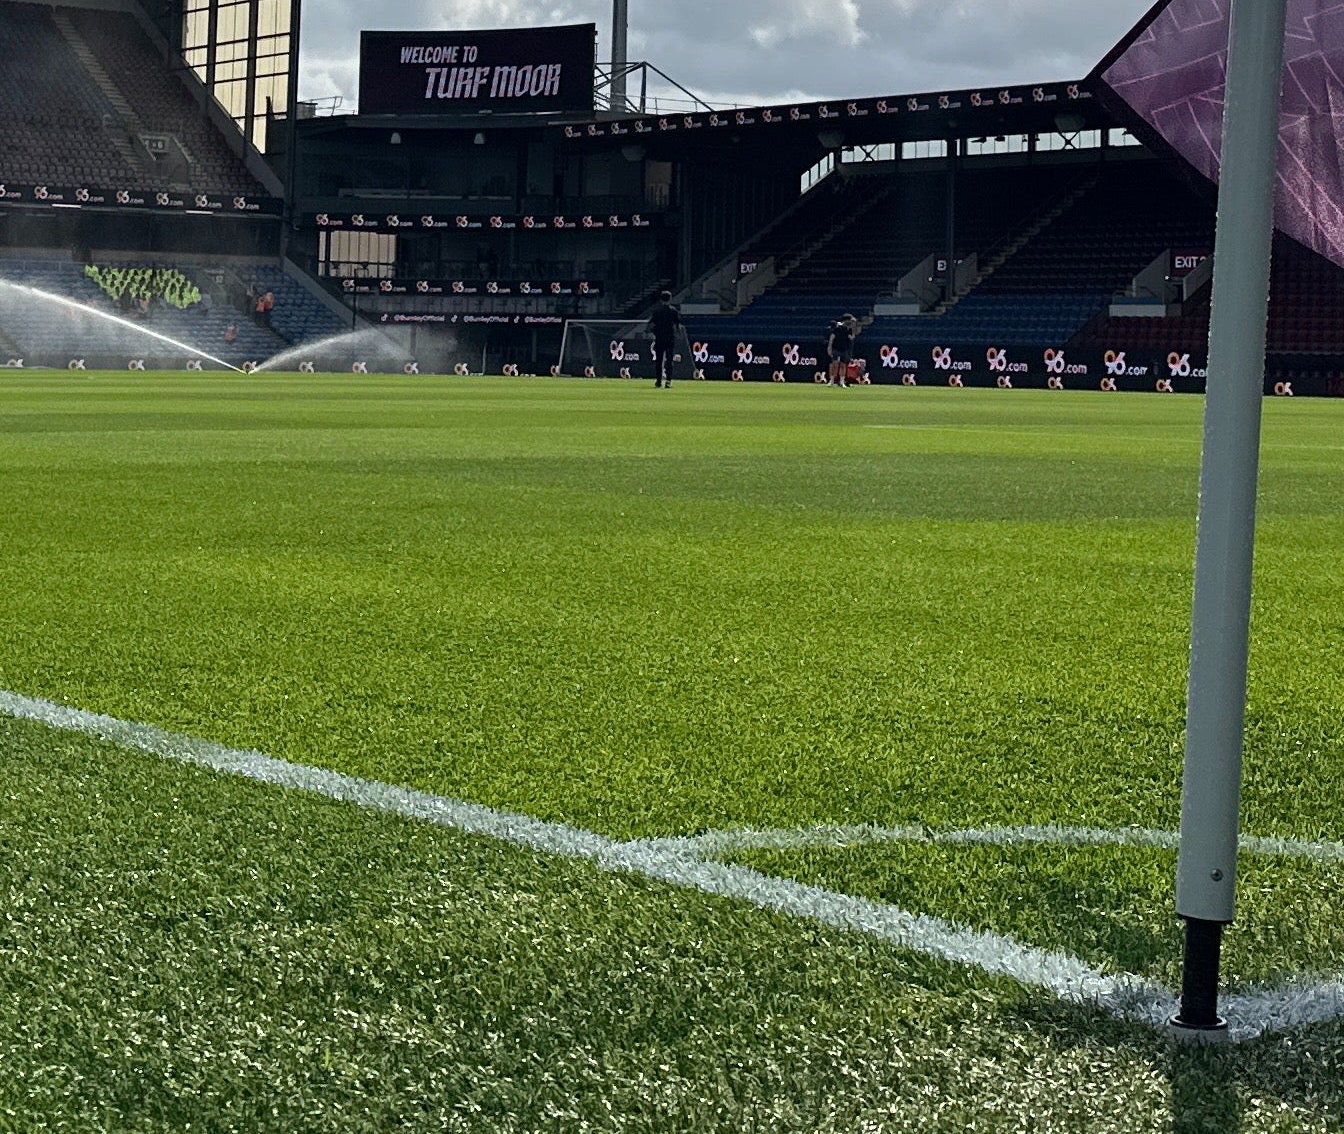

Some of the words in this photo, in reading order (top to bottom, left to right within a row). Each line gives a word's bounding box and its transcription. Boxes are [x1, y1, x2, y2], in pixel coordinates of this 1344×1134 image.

[400, 46, 459, 63] WELCOME
[462, 46, 478, 63] TO
[425, 66, 490, 98] TURF
[490, 64, 562, 98] MOOR
[1175, 256, 1199, 268] EXIT
[609, 340, 640, 361] 96.com
[692, 341, 725, 364] 96.com
[736, 342, 770, 364] 96.com
[782, 343, 817, 366] 96.com
[879, 345, 918, 369] 96.com
[932, 346, 972, 370] 96.com
[986, 347, 1028, 373] 96.com
[1044, 348, 1087, 374] 96.com
[1167, 351, 1207, 378] 96.co
